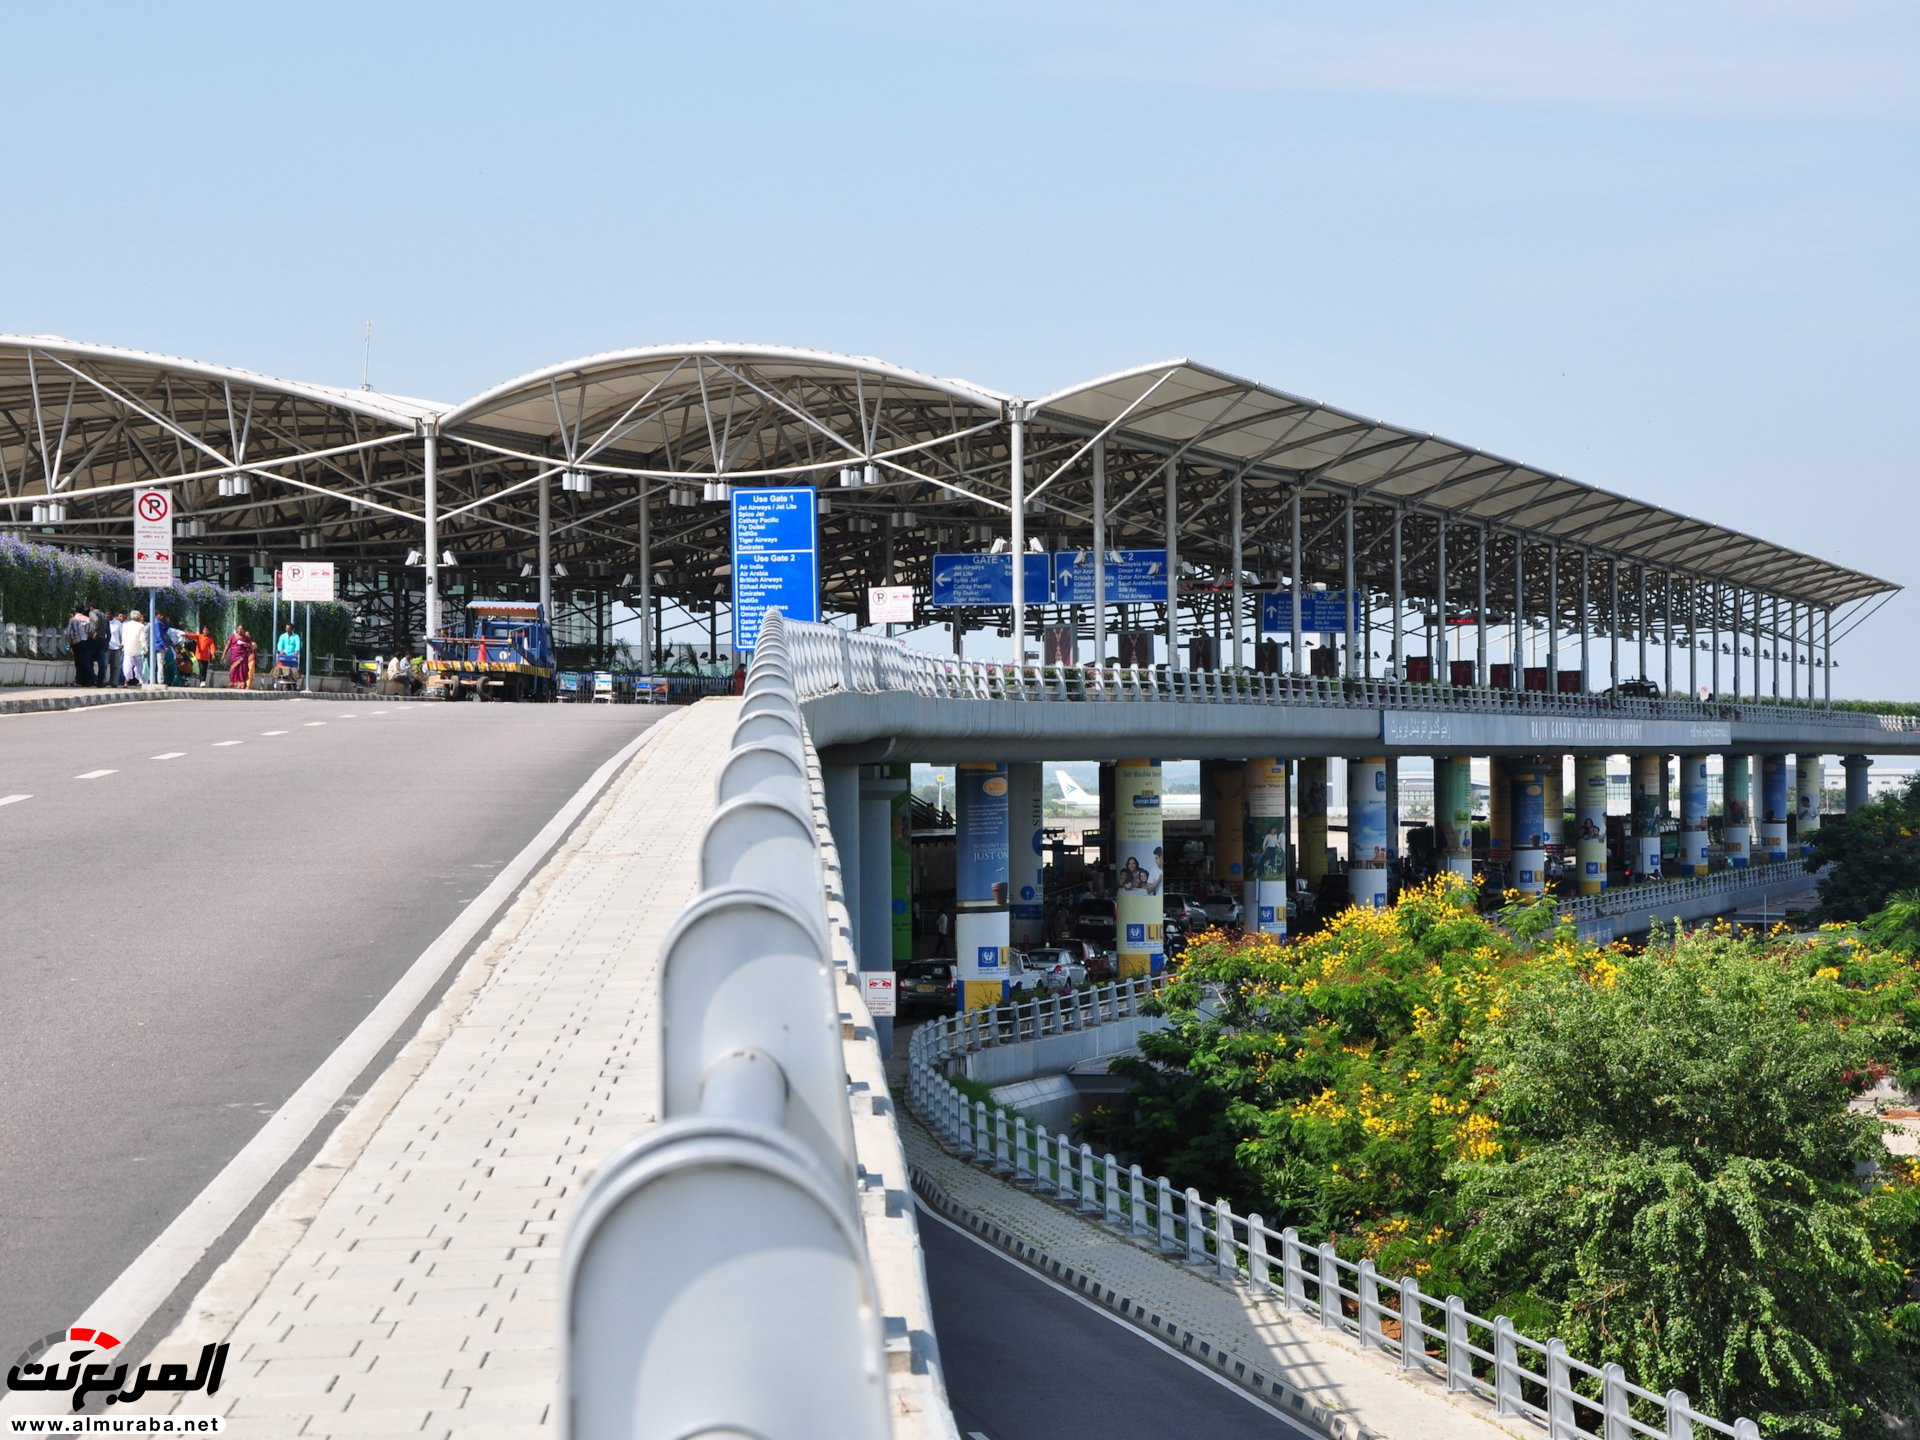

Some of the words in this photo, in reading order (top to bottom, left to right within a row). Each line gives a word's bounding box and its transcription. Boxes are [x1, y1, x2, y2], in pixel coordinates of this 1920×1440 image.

[1531, 721, 1548, 741] RAJIV
[1552, 721, 1574, 738] GANDHI
[1576, 722, 1619, 739] INTERNATIONAL
[1620, 724, 1642, 739] AIRPORT
[974, 852, 994, 861] JUST
